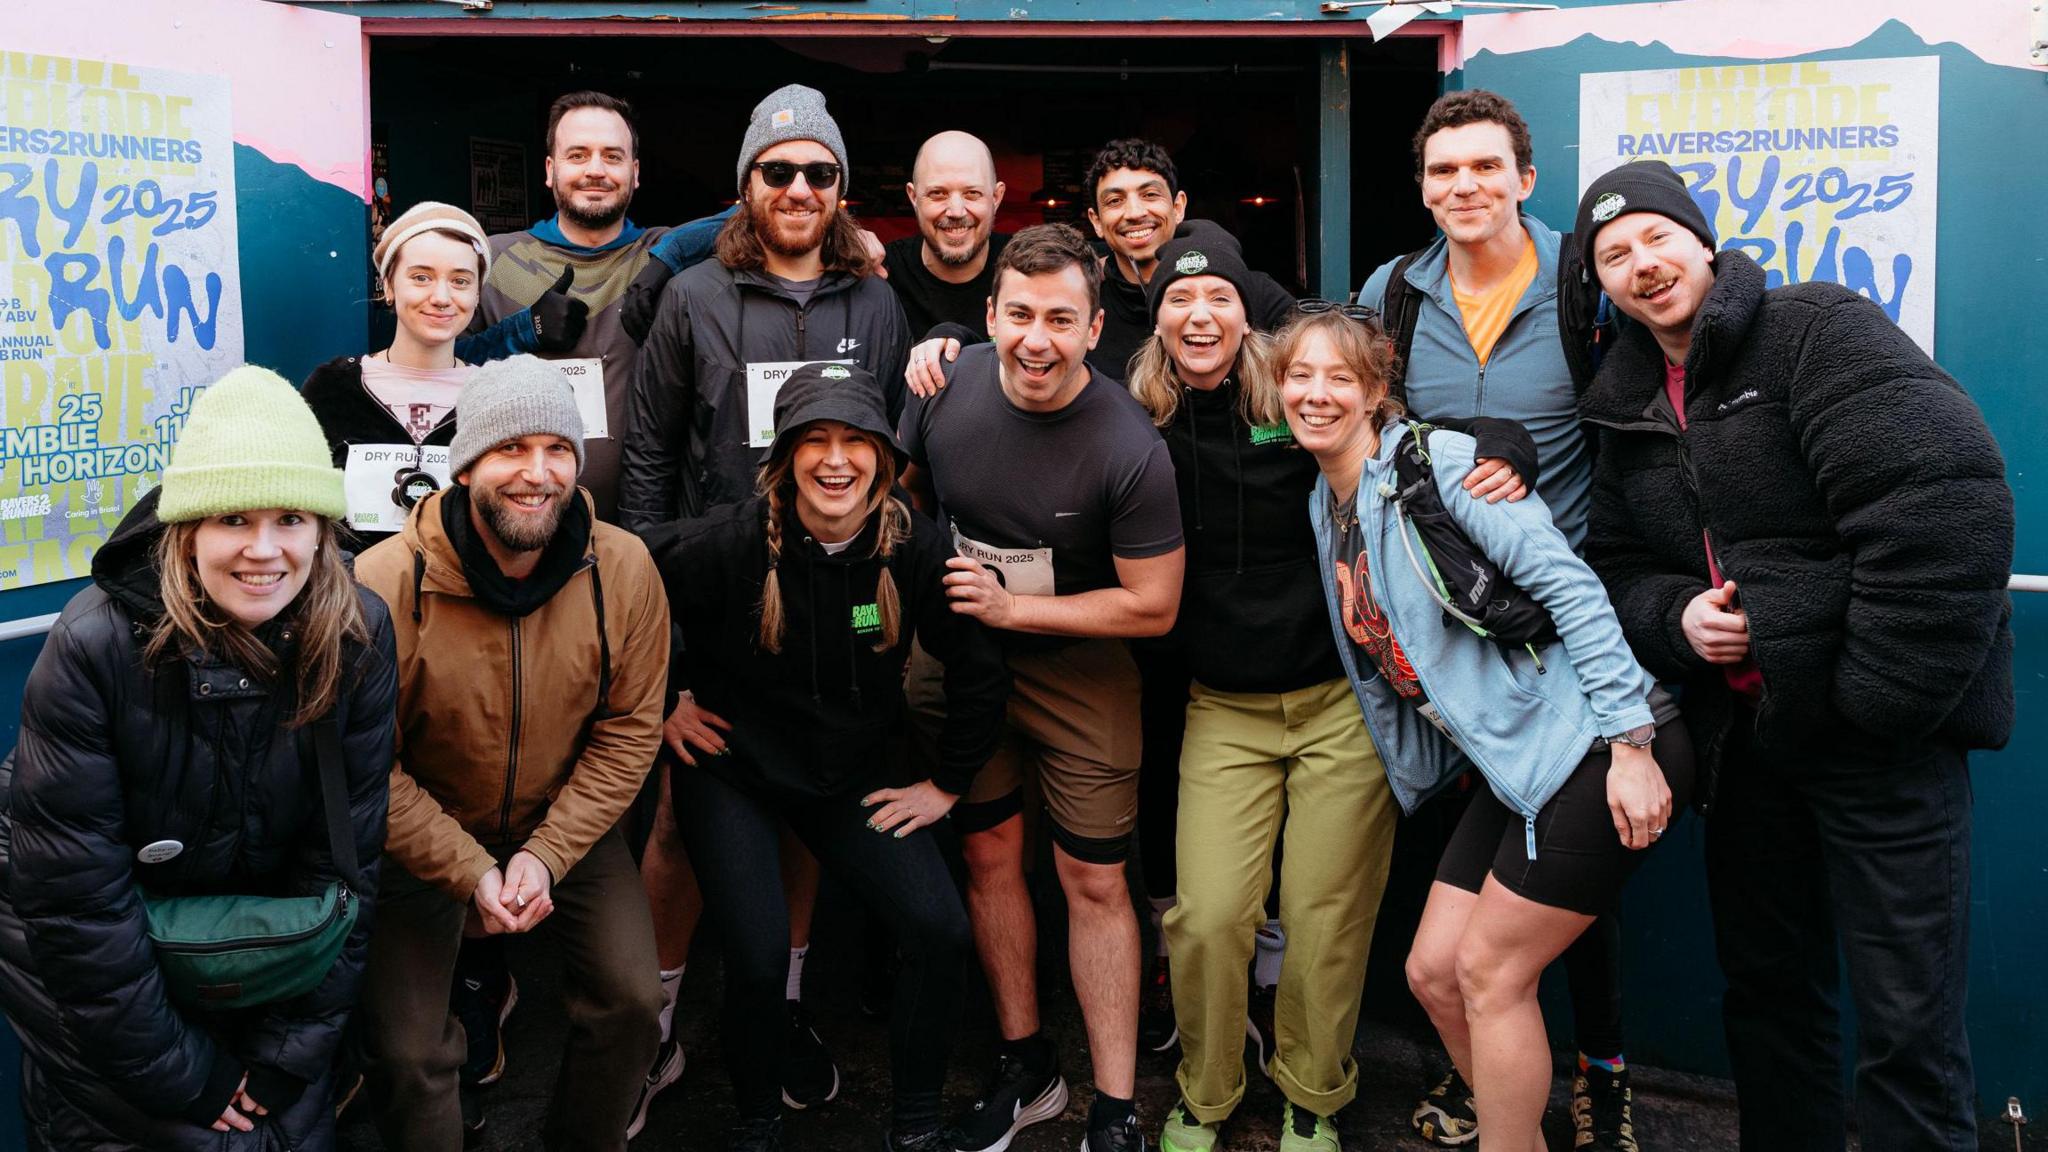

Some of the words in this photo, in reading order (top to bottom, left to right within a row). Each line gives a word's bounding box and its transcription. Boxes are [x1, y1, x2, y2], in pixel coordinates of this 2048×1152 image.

[1617, 125, 1900, 156] RAVERS2RUNNERS
[101, 179, 217, 236] 2025
[1780, 167, 1915, 220] 2025
[45, 235, 222, 350] RUN
[0, 336, 53, 348] NNUAL
[12, 348, 43, 360] RUN
[763, 369, 788, 380] DRY
[58, 393, 103, 424] 25
[22, 443, 171, 486] HORIZON
[364, 452, 392, 462] DRY
[977, 550, 1002, 562] RUN
[1005, 553, 1034, 564] 2025
